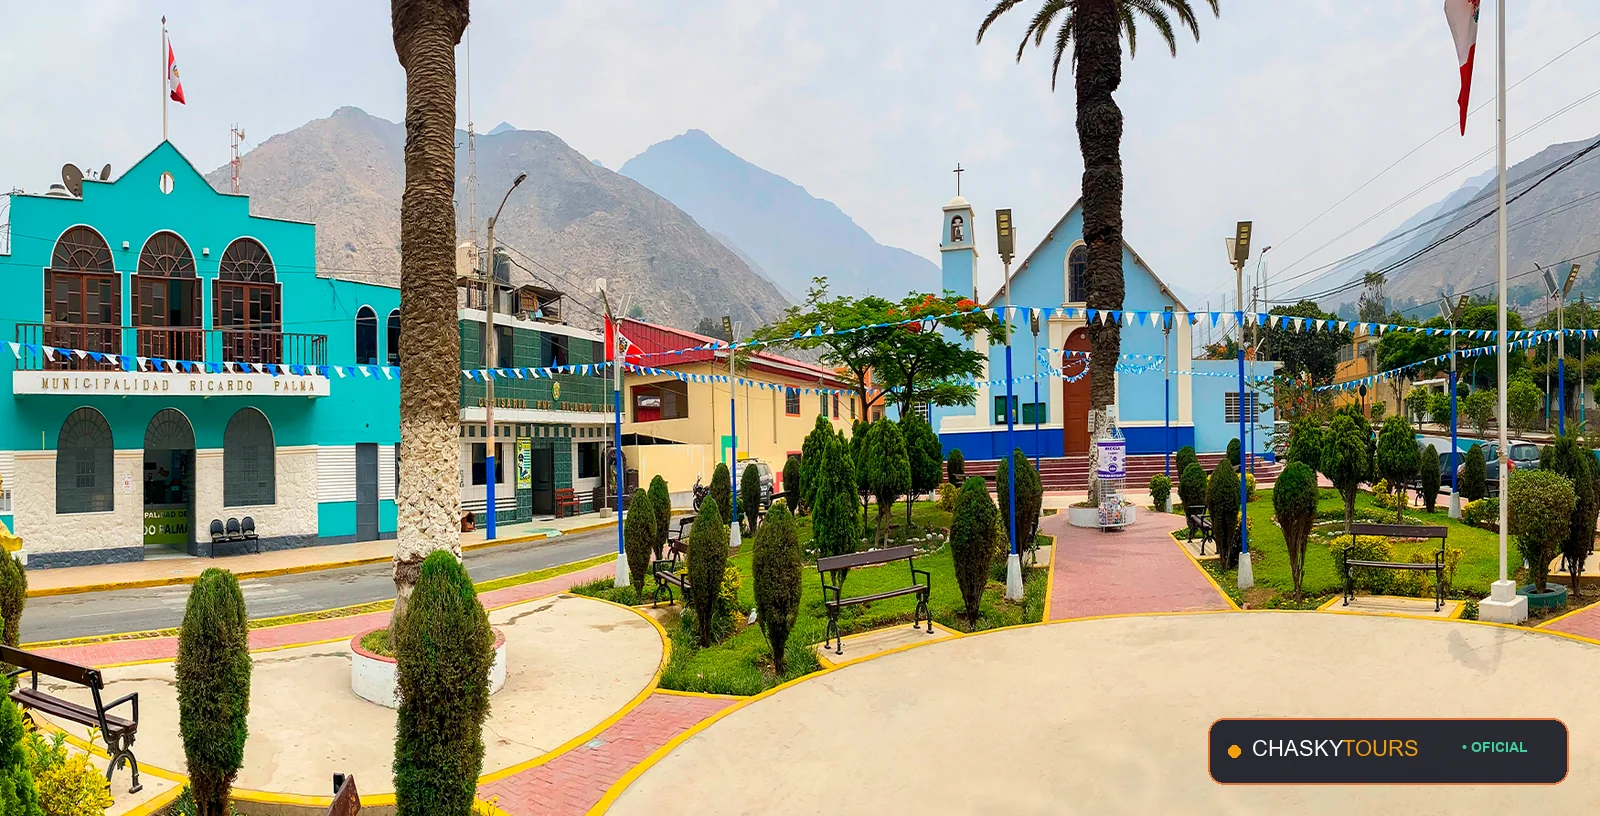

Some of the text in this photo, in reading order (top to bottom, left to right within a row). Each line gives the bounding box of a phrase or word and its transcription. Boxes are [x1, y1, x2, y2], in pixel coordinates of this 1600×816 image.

[41, 377, 315, 391] MUNICIPALIDAD RICARDO PALMA
[478, 397, 527, 409] CMISARIA
